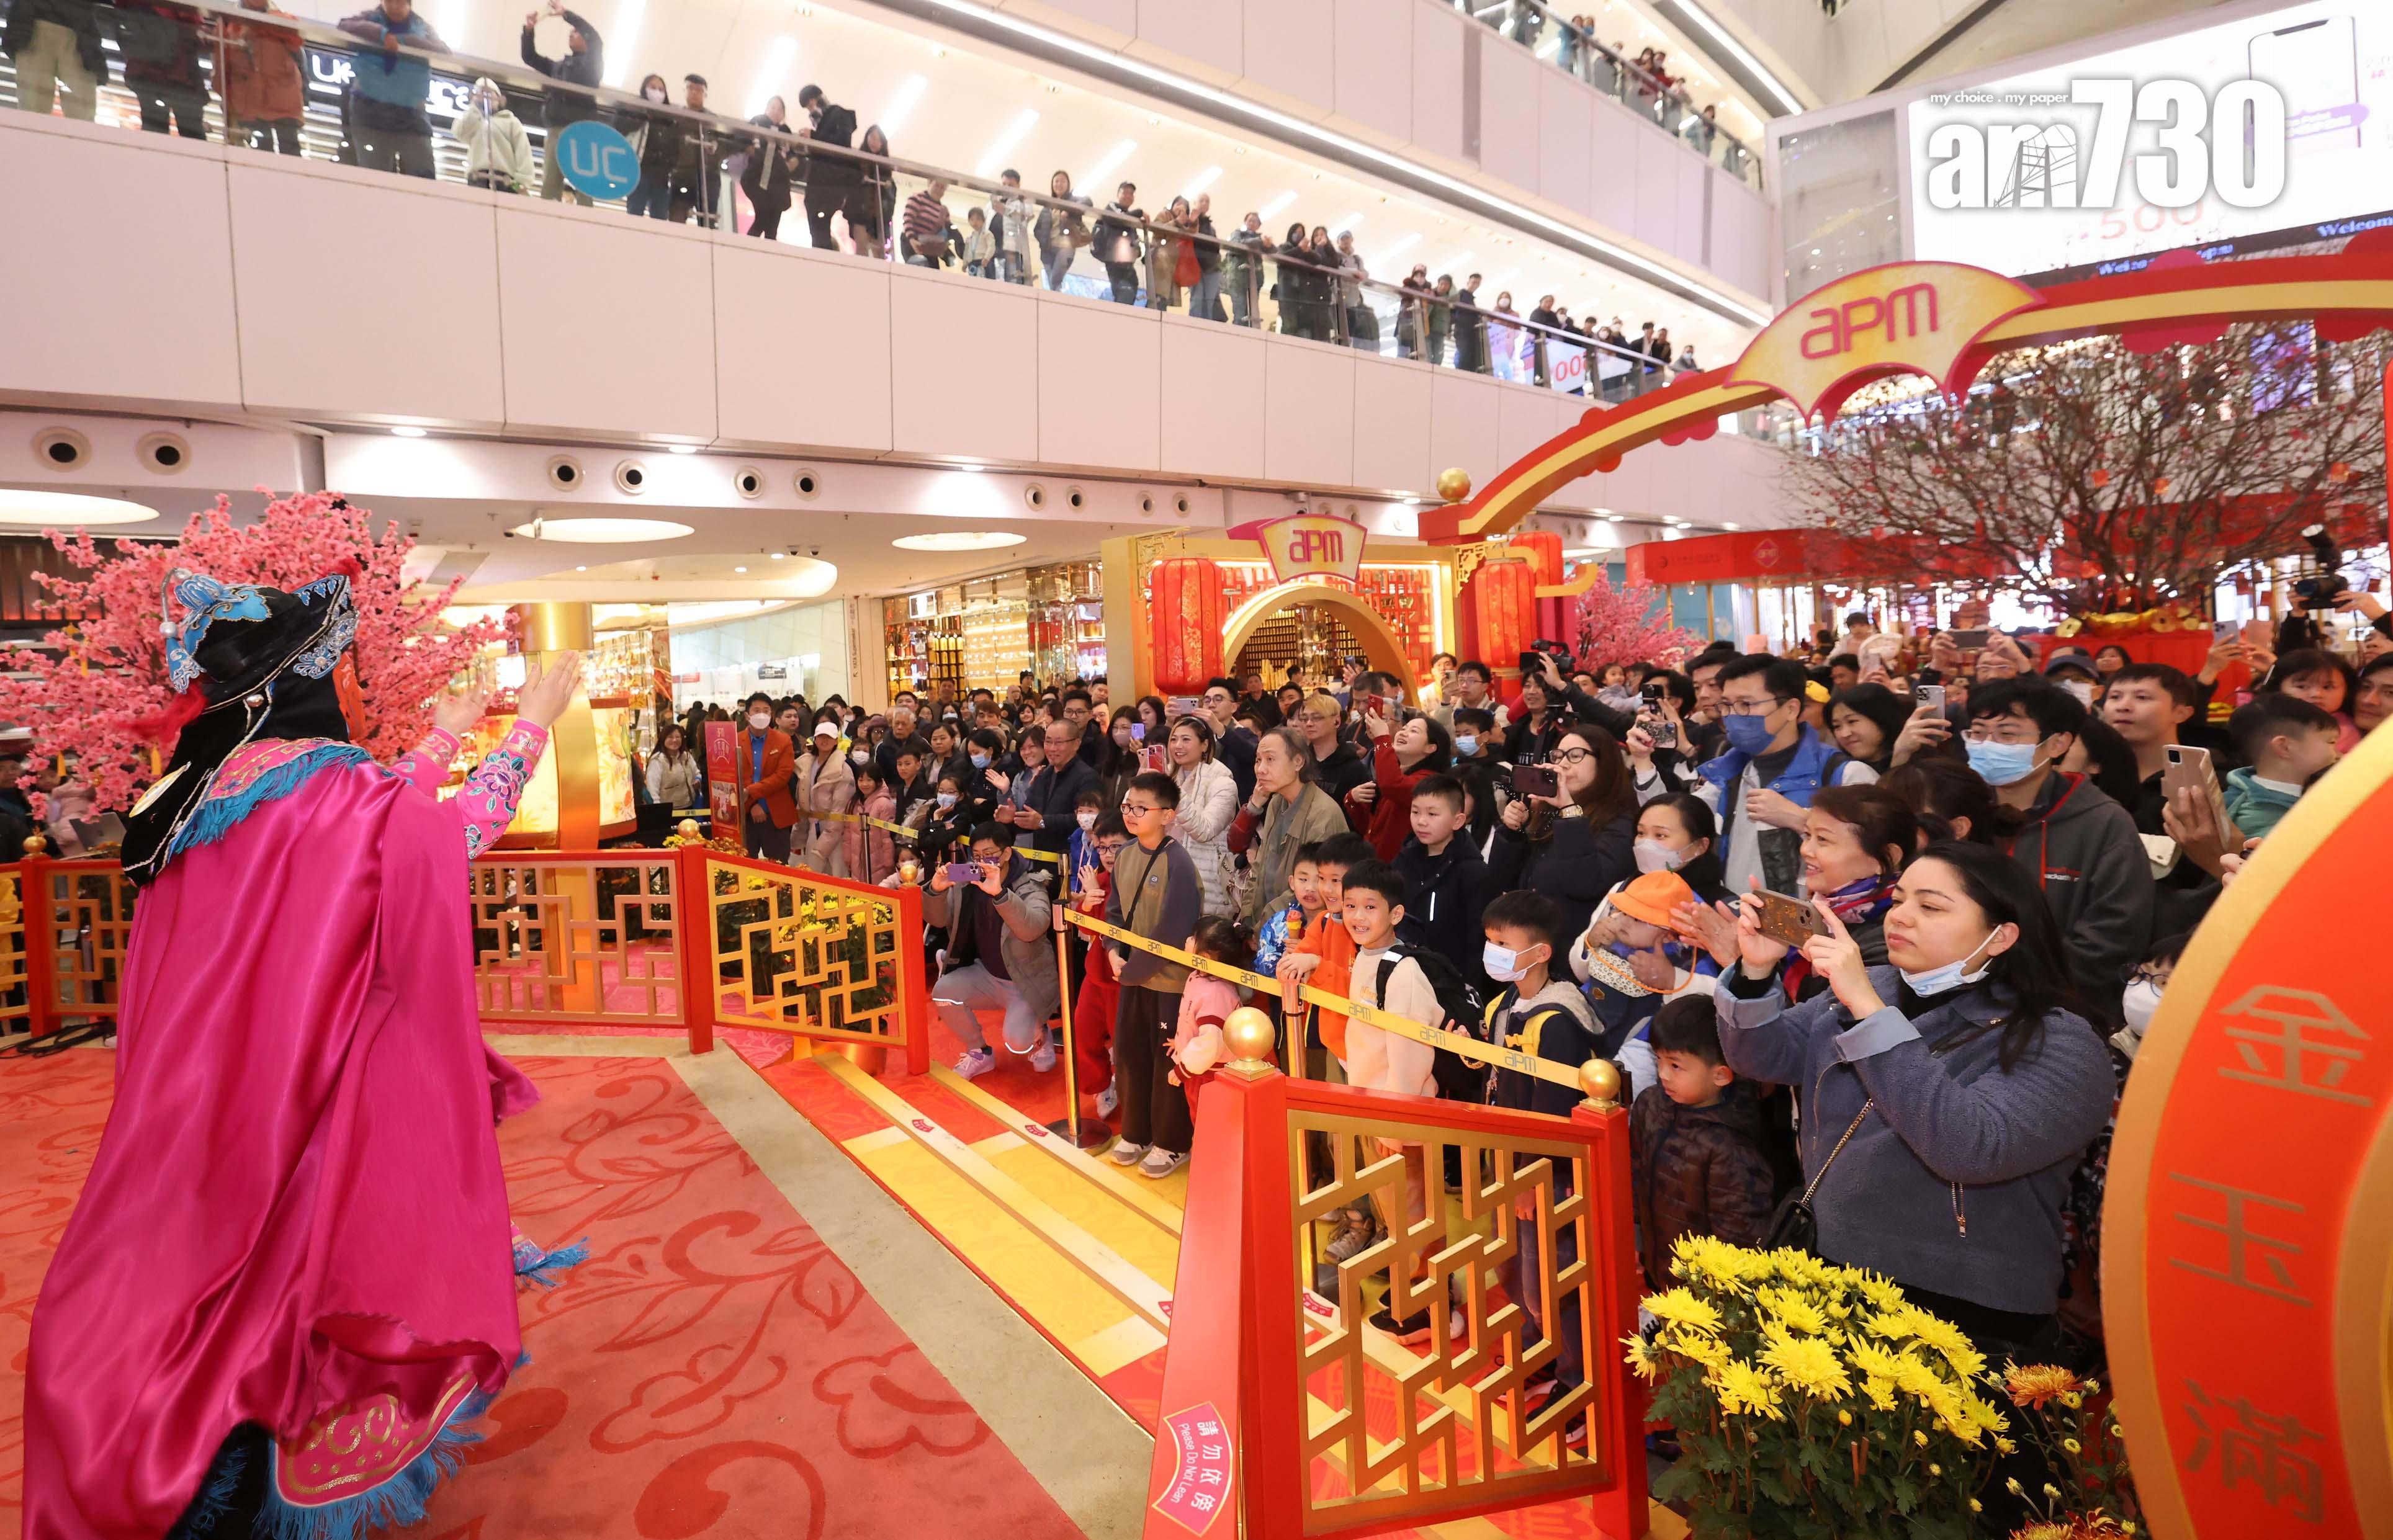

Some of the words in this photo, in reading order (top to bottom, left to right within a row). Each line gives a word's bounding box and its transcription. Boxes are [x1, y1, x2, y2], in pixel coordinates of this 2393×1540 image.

[570, 138, 628, 183] UC
[1178, 1423, 1195, 1450] Please
[1186, 1452, 1198, 1464] Do
[1183, 1466, 1198, 1481] Not
[1170, 1482, 1192, 1504] Lean
